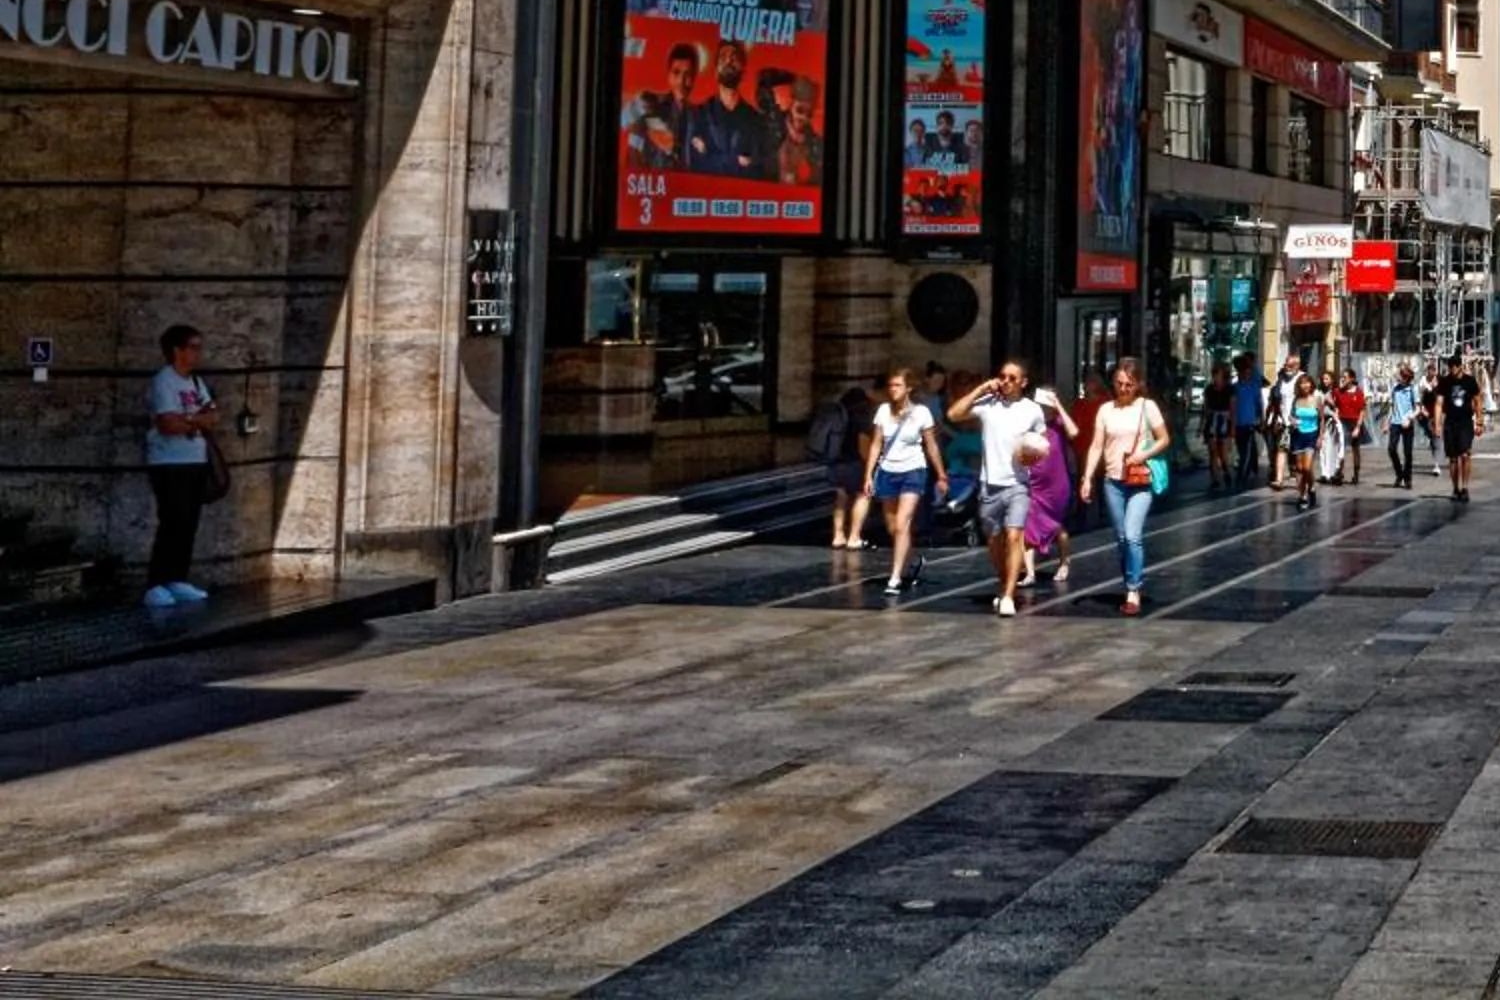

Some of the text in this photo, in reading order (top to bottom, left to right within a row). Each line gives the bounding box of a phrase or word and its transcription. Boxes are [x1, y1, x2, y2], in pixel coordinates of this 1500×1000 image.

[669, 0, 797, 46] CUANDO QUIERA
[146, 1, 360, 87] CAPITOL
[627, 173, 667, 196] SALA
[640, 198, 652, 225] 3
[1293, 234, 1348, 248] GINOS
[1349, 259, 1391, 268] VIPS
